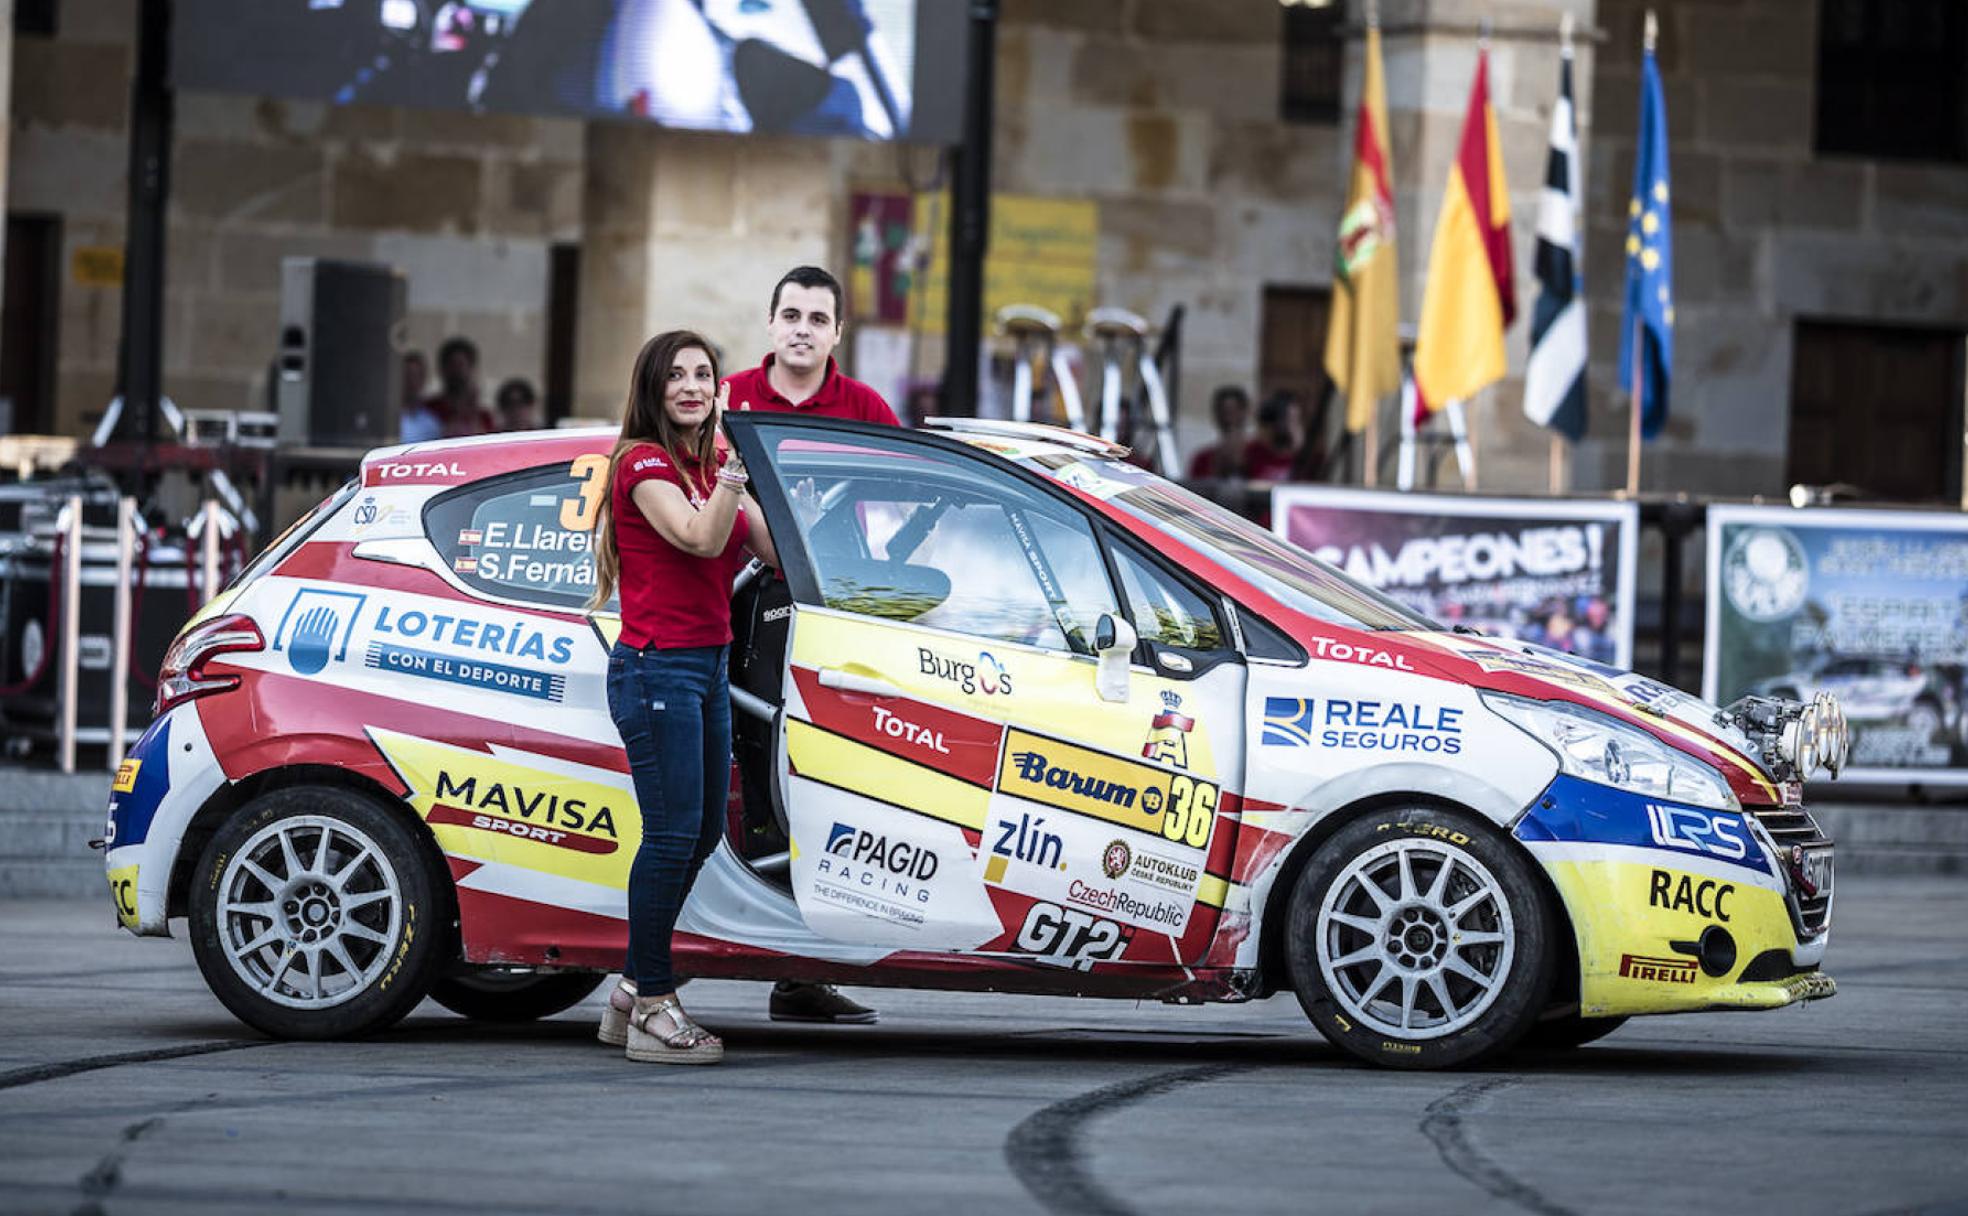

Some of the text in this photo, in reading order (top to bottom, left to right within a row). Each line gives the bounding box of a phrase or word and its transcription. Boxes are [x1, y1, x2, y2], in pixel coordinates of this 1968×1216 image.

[377, 463, 467, 478] TOTAL
[374, 606, 574, 664] LOTERÍAS
[1312, 636, 1415, 671] TOTAL
[388, 652, 542, 692] CON EL DEPORTE
[918, 647, 1012, 695] Burgos
[872, 706, 950, 755] TOTAL
[1325, 698, 1464, 733] REALE
[1321, 730, 1461, 755] SEGUROS
[436, 770, 618, 838] MAVISA
[1012, 751, 1138, 809] Barum
[1163, 775, 1218, 848] 36
[472, 815, 567, 843] SPORT
[853, 830, 939, 881] PAGID
[1135, 855, 1198, 882] AUTOKLUB
[814, 884, 830, 897] THE
[831, 887, 880, 911] DIFFERENCE
[818, 859, 931, 903] RACING
[1650, 869, 1735, 922] RACC
[1069, 879, 1184, 927] CzechRepublic
[1619, 953, 1699, 984] PIRELLI
